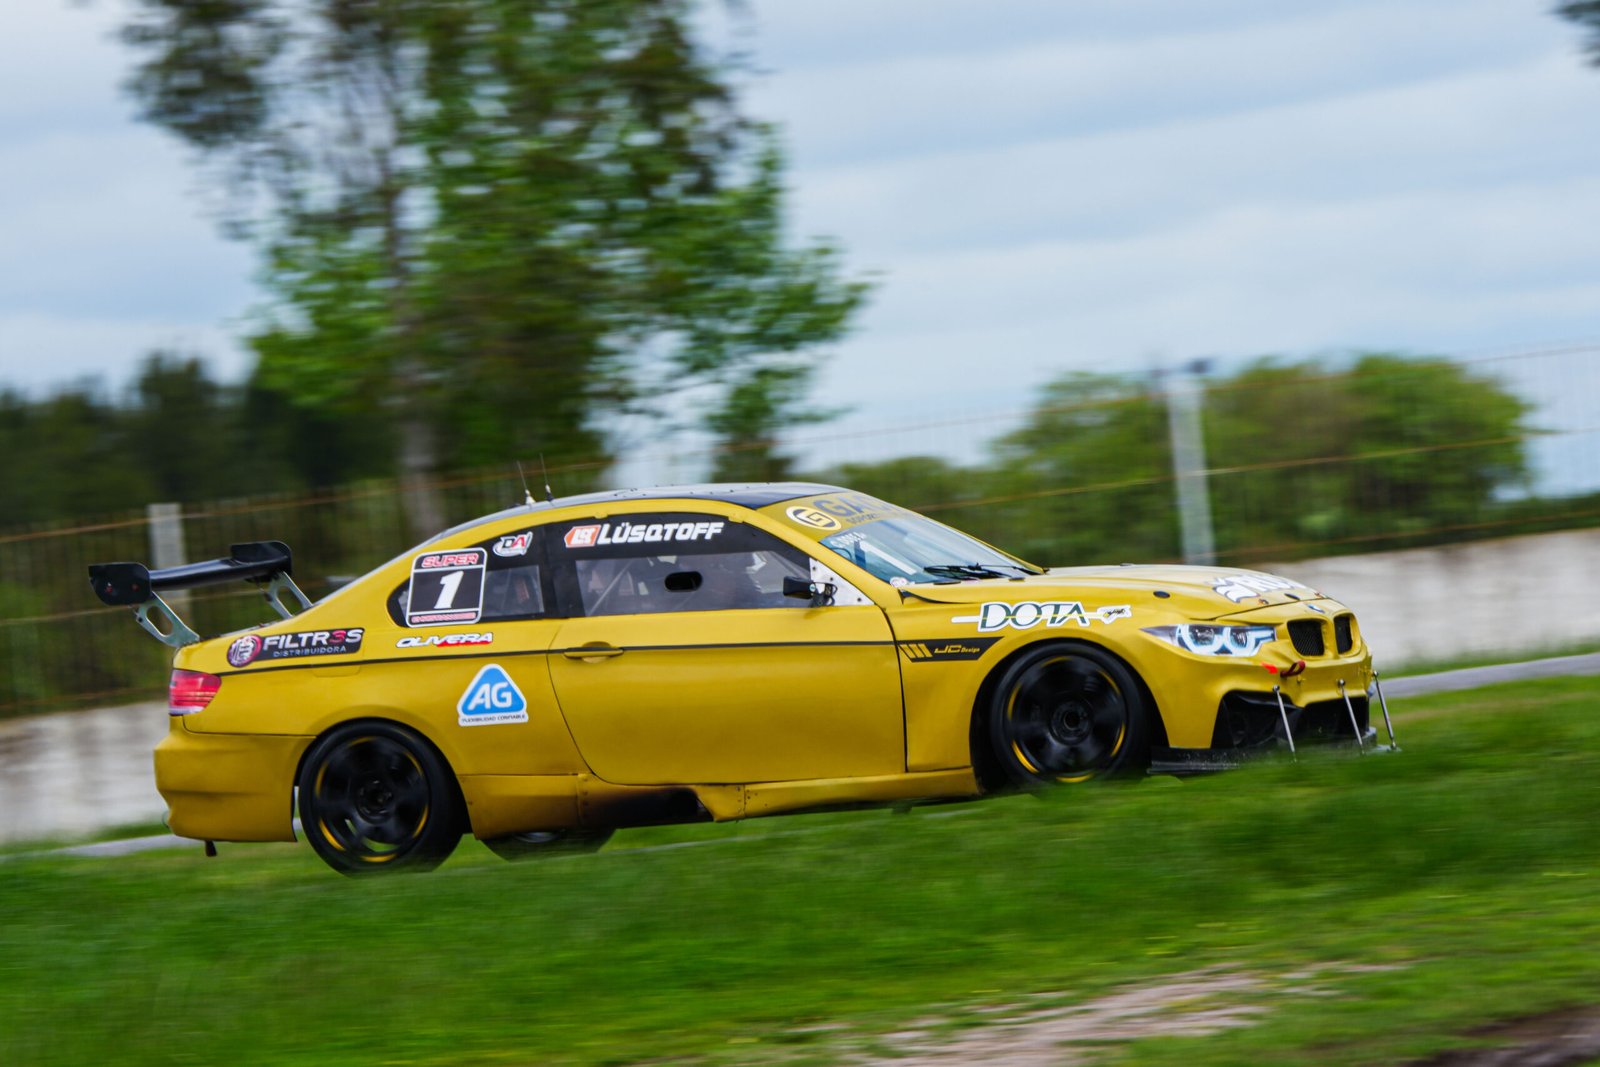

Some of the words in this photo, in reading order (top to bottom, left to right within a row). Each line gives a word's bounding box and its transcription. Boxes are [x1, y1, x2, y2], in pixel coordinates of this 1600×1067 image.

[421, 552, 479, 568] SUPER
[433, 570, 465, 609] 1
[979, 602, 1089, 630] DOTA
[262, 628, 364, 651] FILTR3S
[396, 632, 493, 648] OLIVERA
[273, 646, 347, 658] DISTRIBUIDORA
[467, 681, 513, 710] AG
